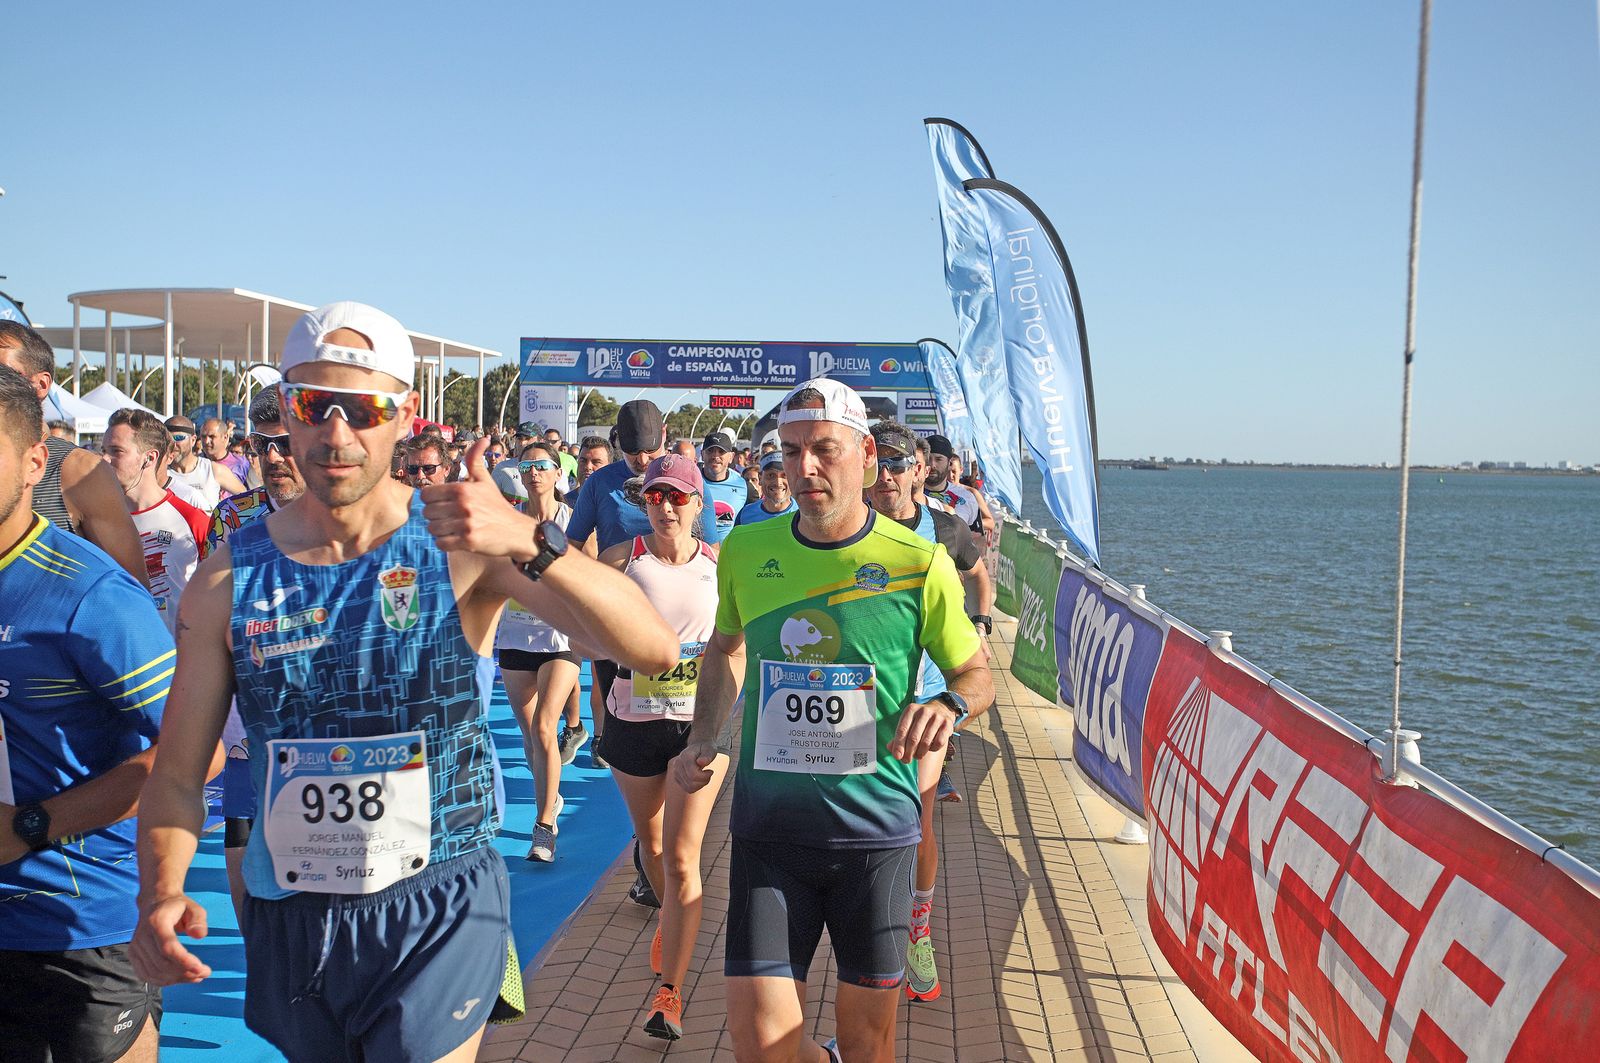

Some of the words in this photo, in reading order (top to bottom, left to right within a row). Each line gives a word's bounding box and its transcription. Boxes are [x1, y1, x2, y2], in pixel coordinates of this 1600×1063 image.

[668, 346, 763, 359] CAMPEONATO
[667, 361, 682, 372] de
[685, 360, 733, 372] ESPAÑA
[740, 360, 762, 375] 10
[768, 359, 797, 375] km
[832, 357, 871, 370] HUELVA
[782, 671, 806, 682] HUELVA
[832, 672, 864, 686] 2023
[665, 700, 686, 708] Syrluz
[785, 693, 845, 725] 969
[788, 729, 806, 737] JOSE
[807, 730, 842, 739] ANTONIO
[790, 739, 820, 748] FRUSTO
[821, 741, 840, 749] RUIZ
[298, 751, 327, 765] HUELVA
[363, 745, 410, 767] 2023
[766, 756, 798, 765] HYUNDAI
[804, 753, 835, 765] Syrluz
[301, 780, 385, 824] 938
[308, 833, 340, 843] JORGE
[341, 832, 385, 843] MANUEL
[292, 845, 350, 857] FERNÁNDEZ
[335, 865, 375, 879] Syrluz
